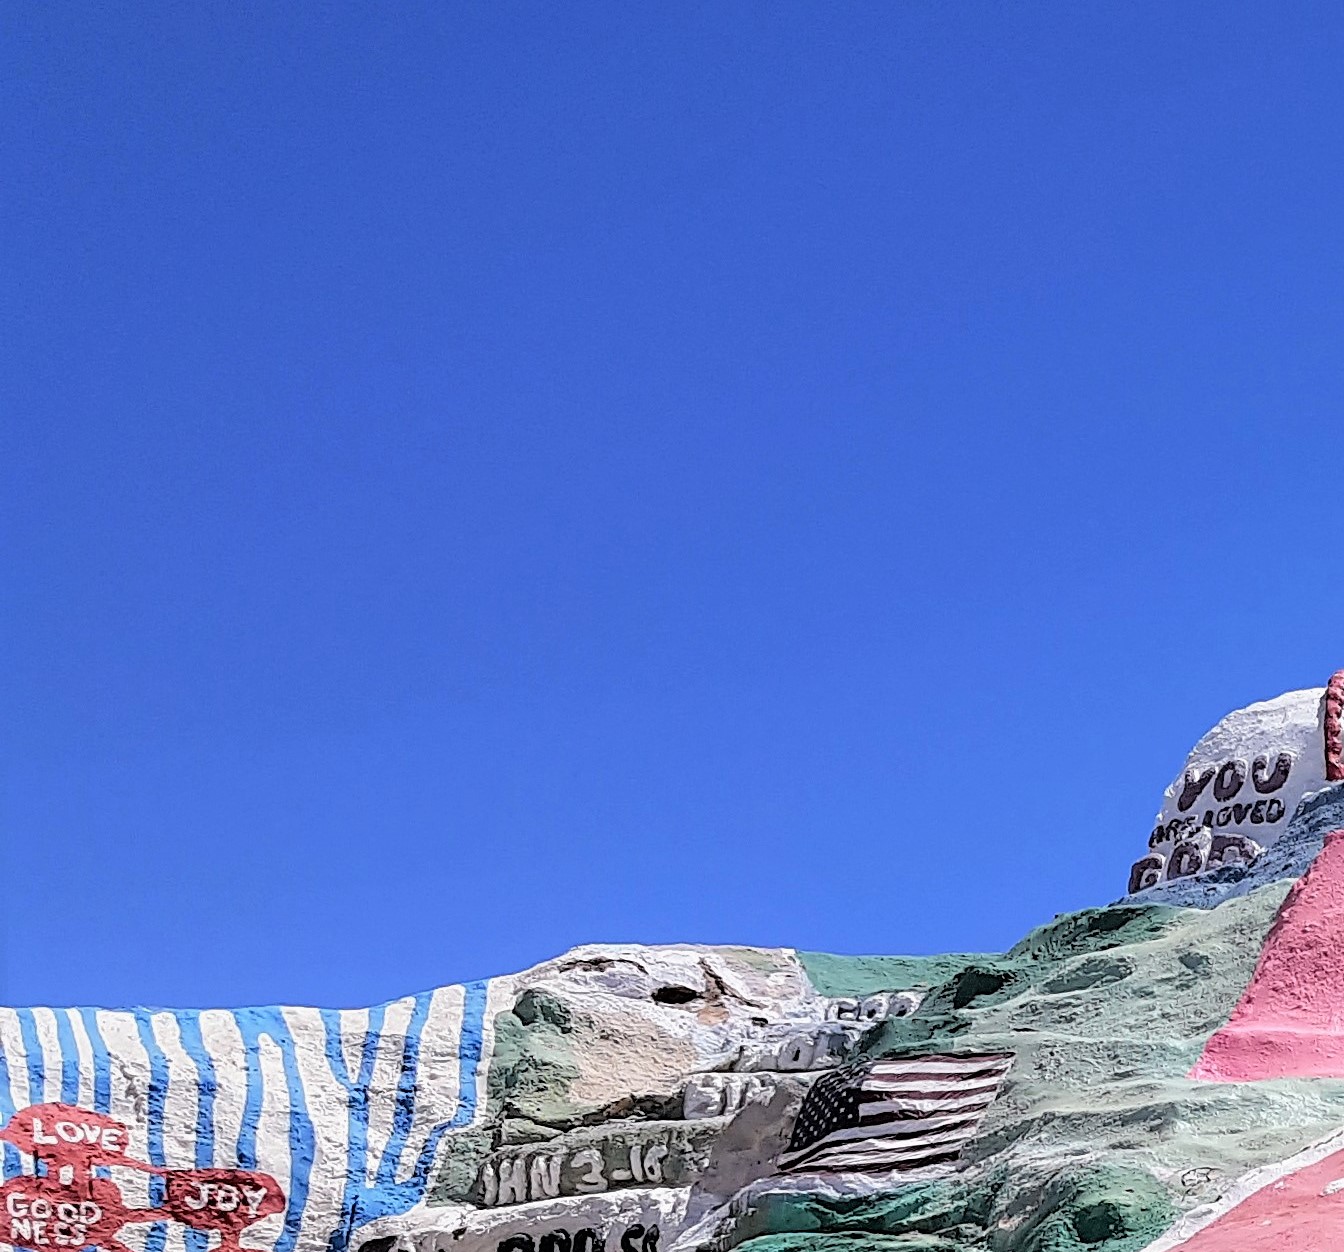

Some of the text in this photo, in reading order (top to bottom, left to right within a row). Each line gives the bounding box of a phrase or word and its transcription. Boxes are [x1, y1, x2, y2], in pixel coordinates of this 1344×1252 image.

[1177, 753, 1292, 812] YOU
[1202, 799, 1286, 829] LOVED
[32, 1118, 122, 1150] LOVE
[6, 1191, 102, 1225] GOOD
[185, 1183, 267, 1219] JOY
[10, 1218, 88, 1246] NESS
